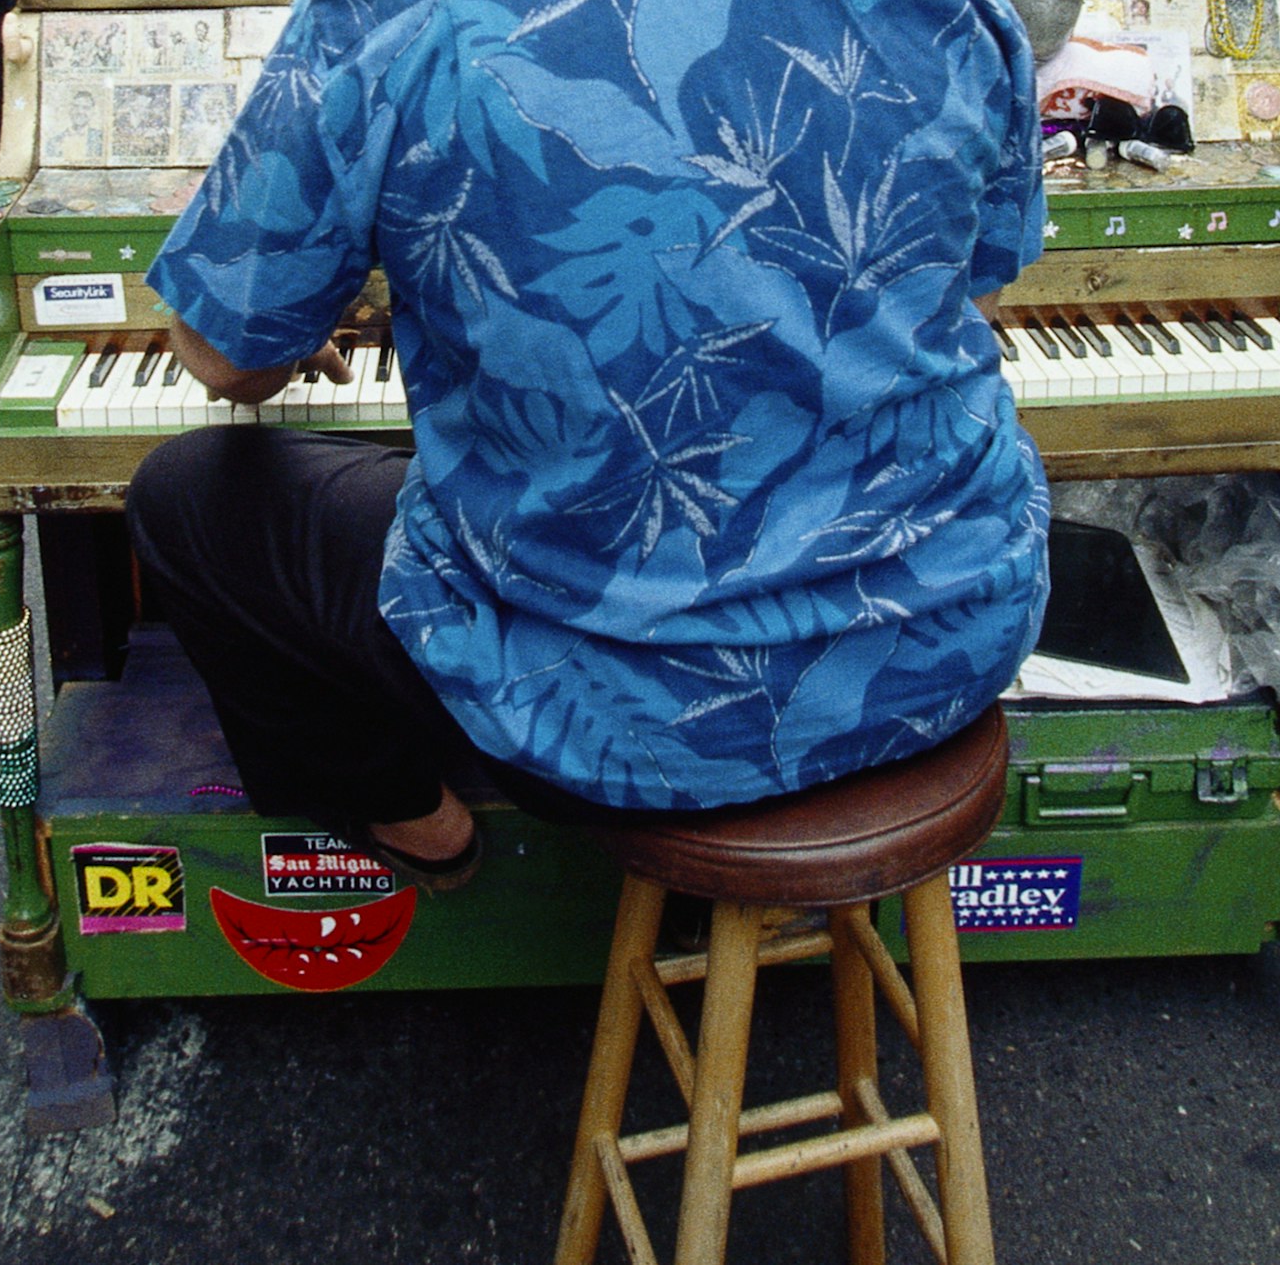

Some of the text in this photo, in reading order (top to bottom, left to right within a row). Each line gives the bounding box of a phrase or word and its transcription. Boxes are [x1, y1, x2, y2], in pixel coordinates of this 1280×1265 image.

[50, 285, 108, 299] SecurityLink
[269, 854, 311, 871] San
[271, 876, 390, 890] YACHTING
[948, 864, 982, 888] ill
[84, 865, 172, 909] DR
[951, 883, 1066, 911] adley
